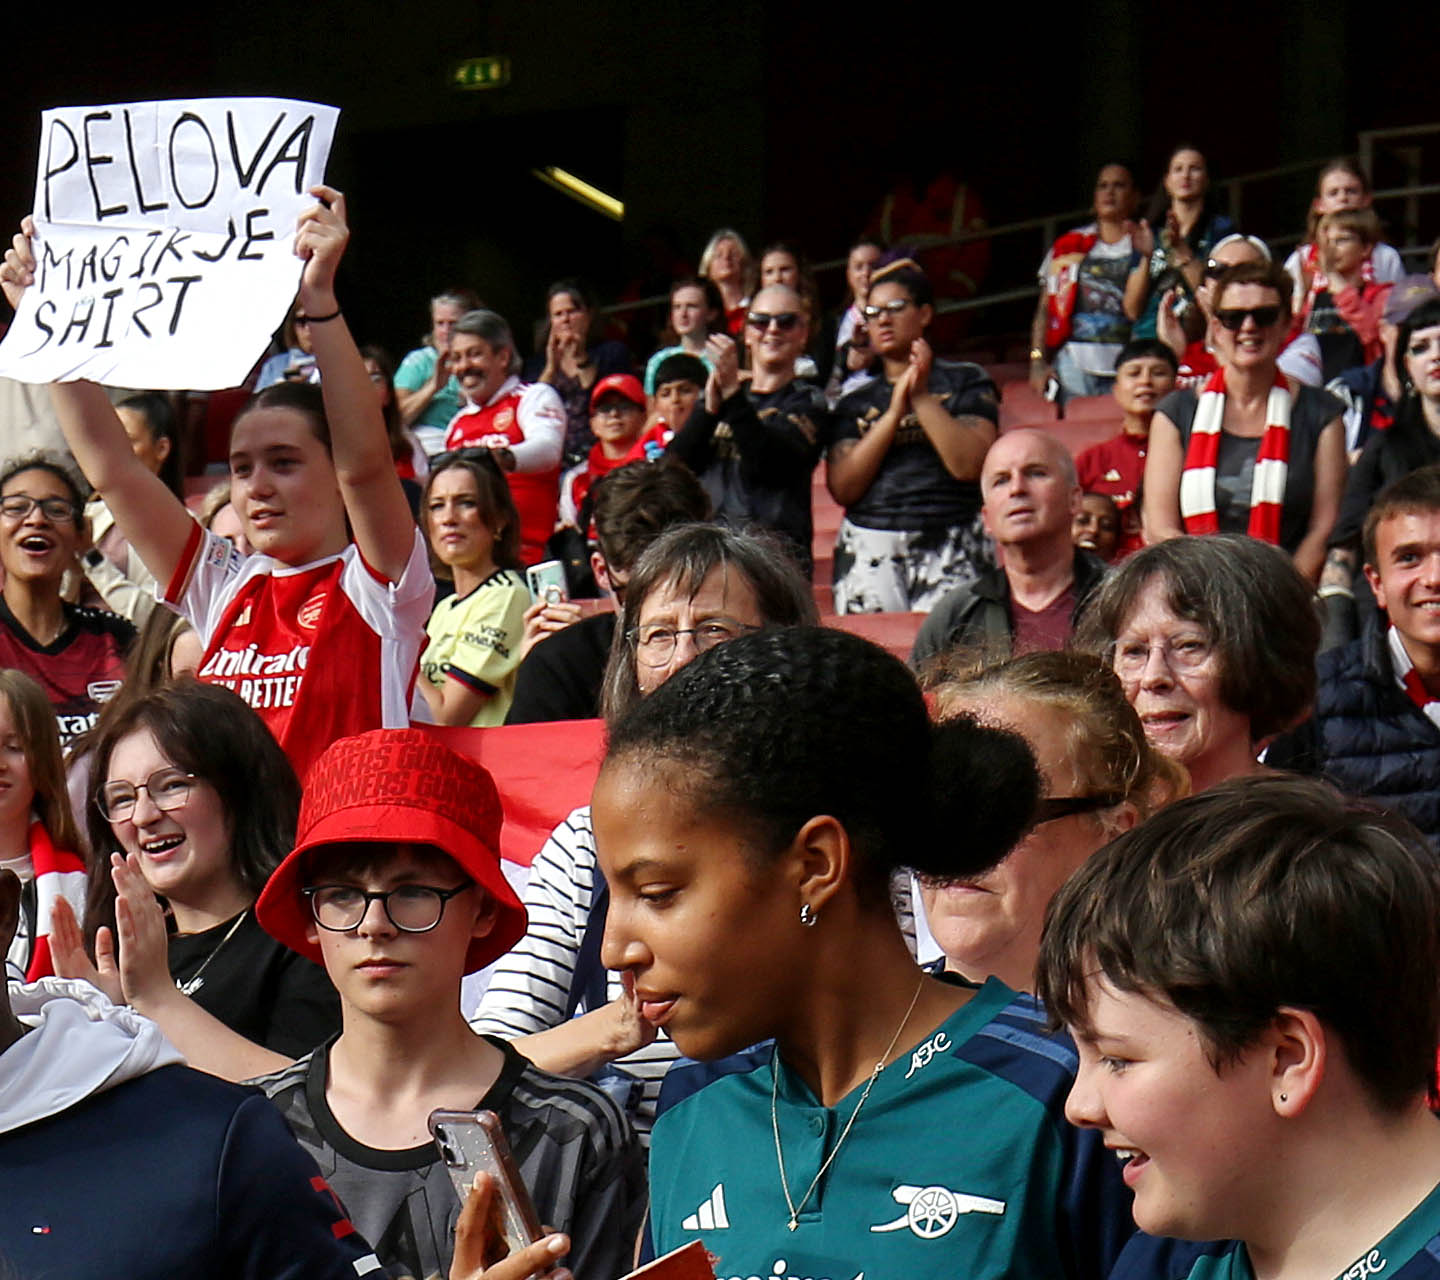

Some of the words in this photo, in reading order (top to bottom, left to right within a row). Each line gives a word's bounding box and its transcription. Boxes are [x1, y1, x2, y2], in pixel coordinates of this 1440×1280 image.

[43, 109, 315, 223] PELOVA
[22, 274, 203, 358] SHIRT
[904, 1031, 952, 1080] AFC
